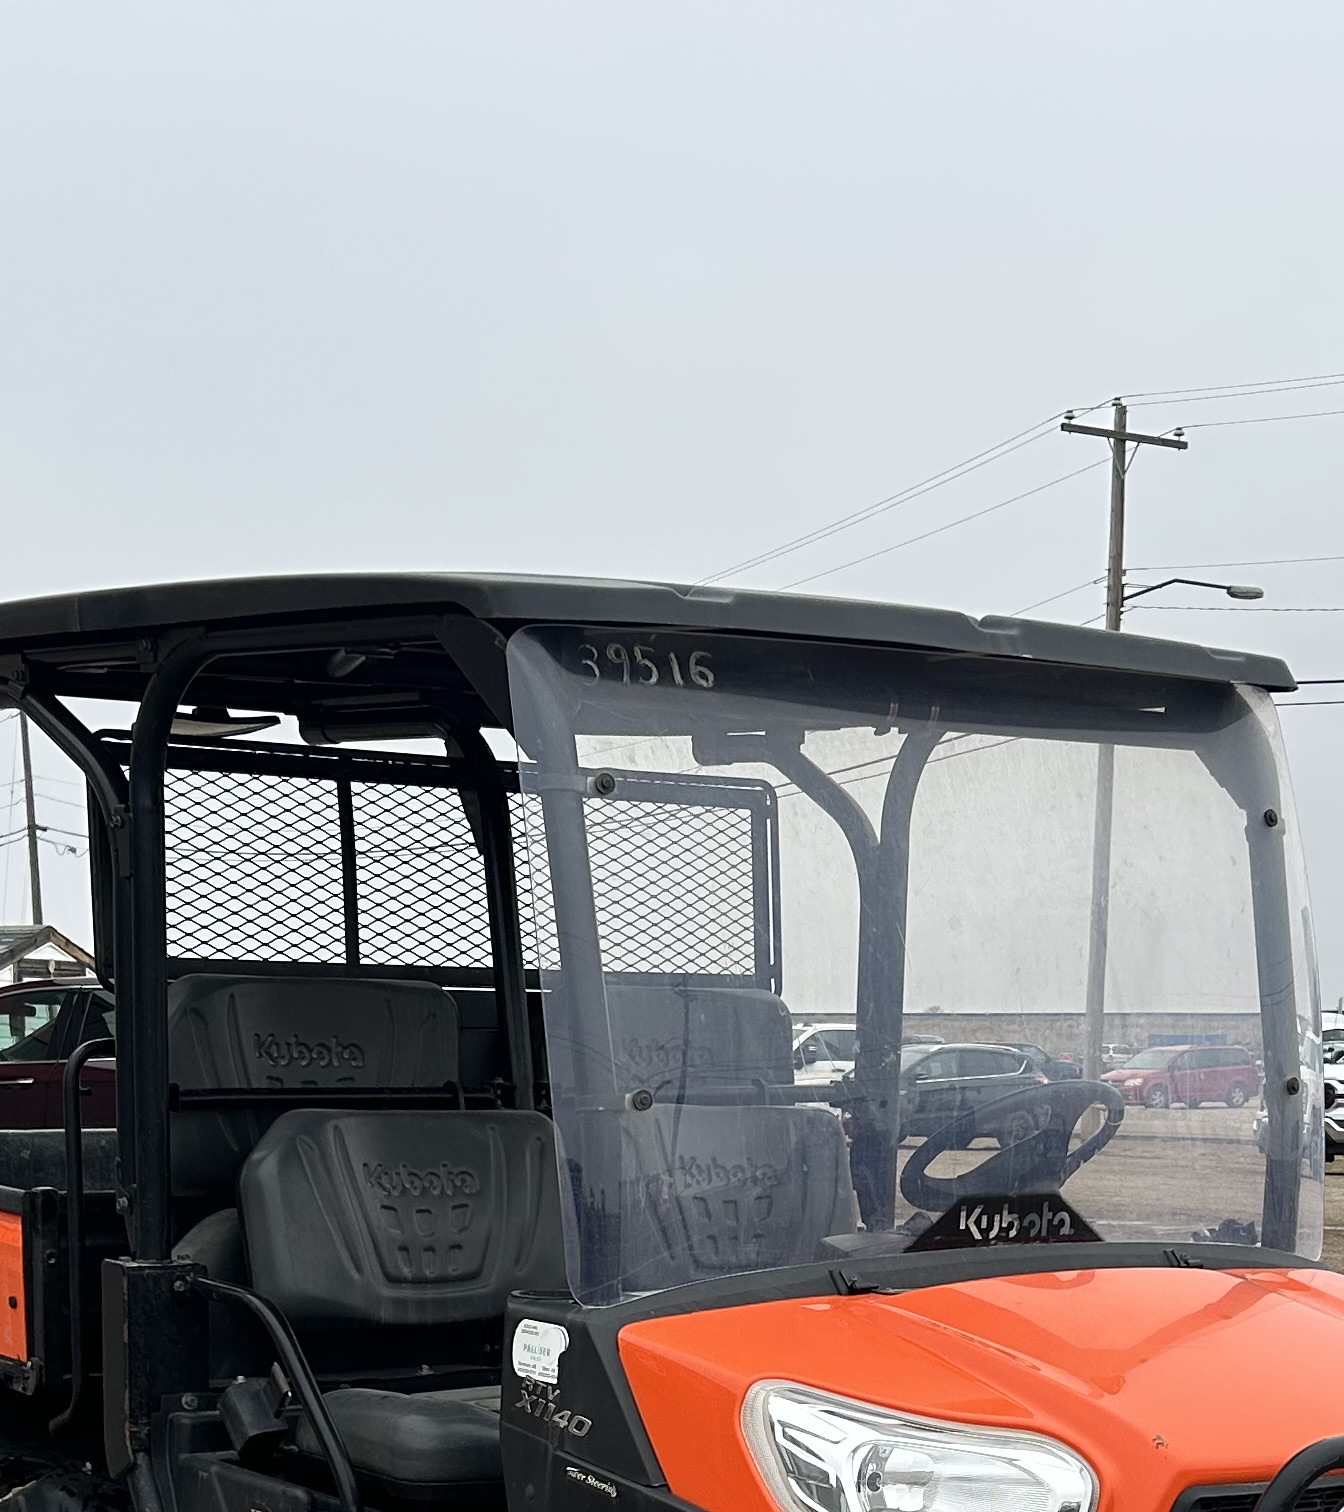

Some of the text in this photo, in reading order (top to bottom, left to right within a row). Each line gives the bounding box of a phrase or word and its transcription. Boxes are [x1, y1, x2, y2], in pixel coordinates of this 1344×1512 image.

[577, 642, 716, 689] 39516
[253, 1032, 366, 1069] Kubota
[361, 1161, 482, 1197] Kubota
[959, 1201, 1075, 1240] Kubota
[521, 1375, 561, 1401] RTV
[515, 1389, 594, 1438] X1140
